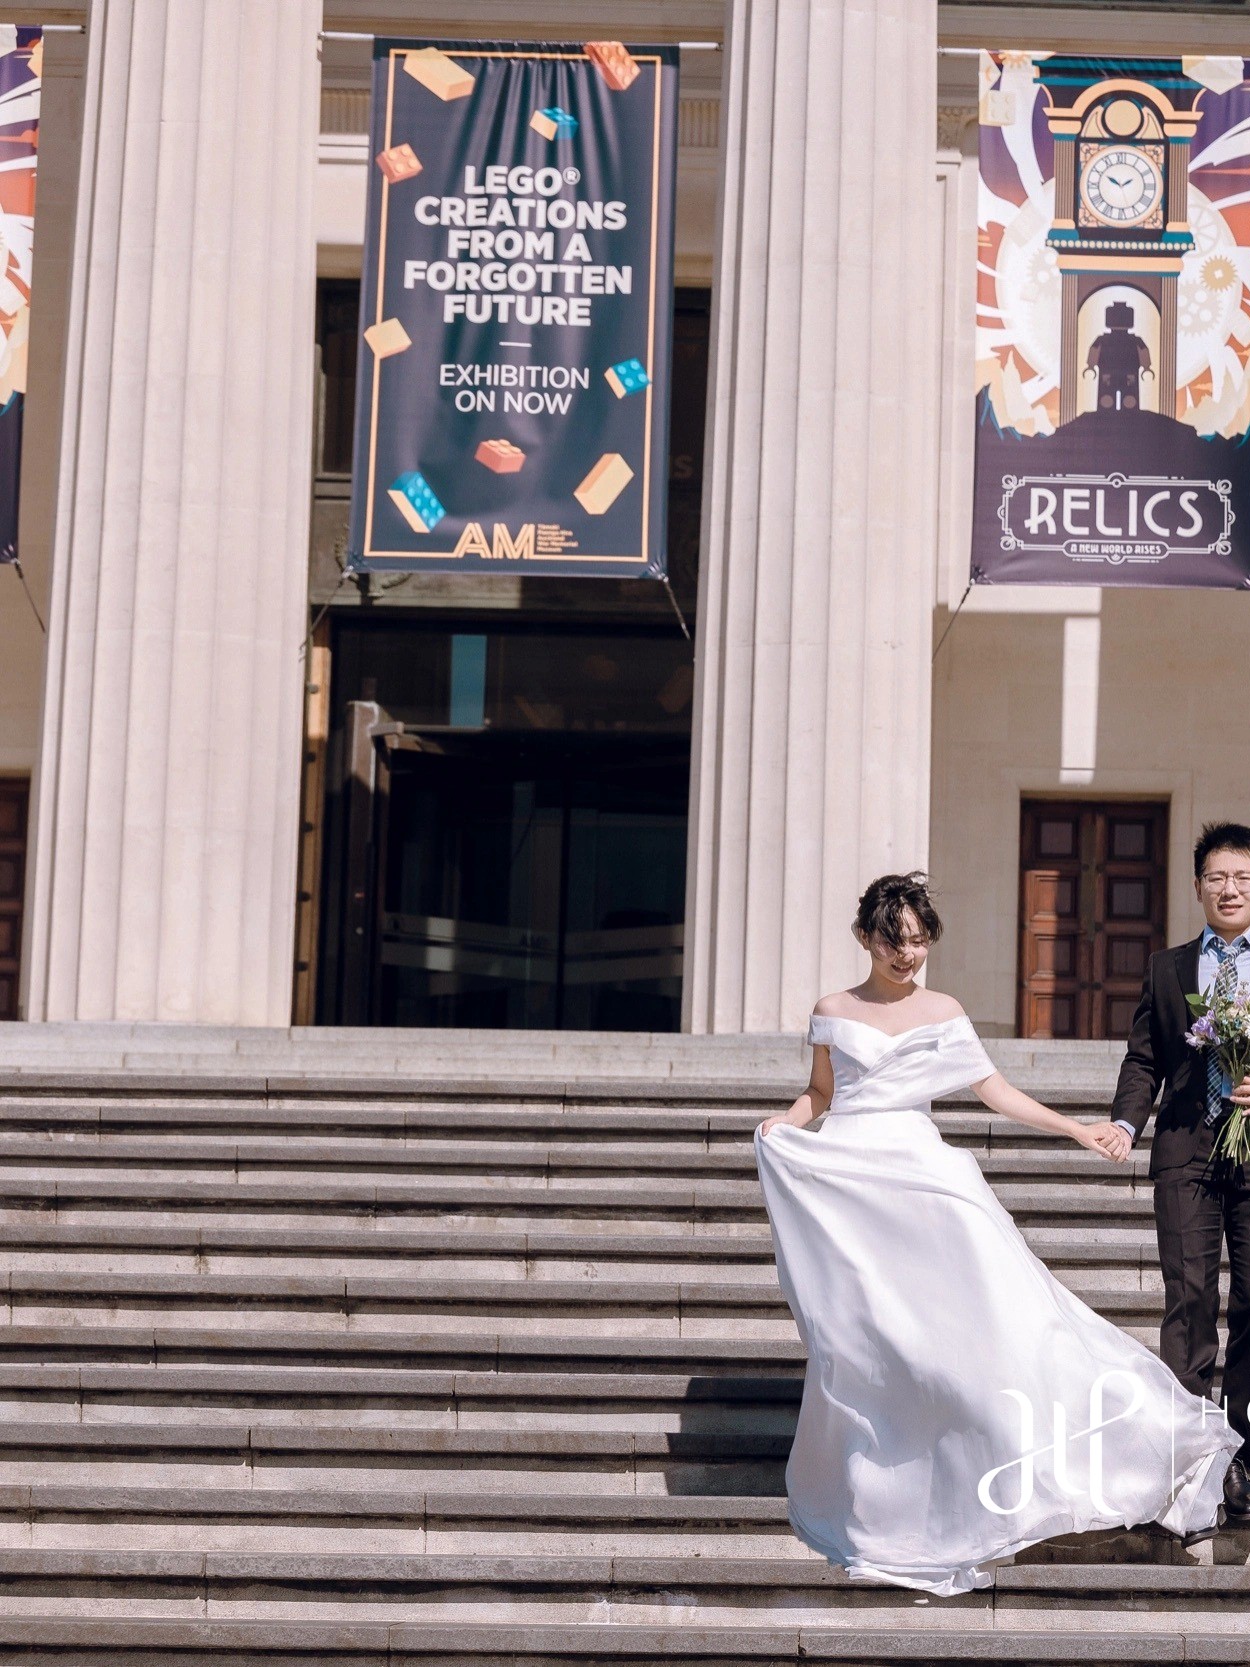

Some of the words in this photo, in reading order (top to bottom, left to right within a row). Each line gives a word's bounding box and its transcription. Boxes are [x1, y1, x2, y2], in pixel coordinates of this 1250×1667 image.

[414, 196, 628, 230] CREATIONS
[447, 229, 555, 260] FROM
[562, 233, 593, 262] A
[404, 260, 633, 294] FORGOTTEN
[443, 294, 592, 326] FUTURE
[439, 363, 590, 389] EXHIBITION
[455, 390, 496, 412] ON
[503, 390, 573, 415] NOW
[1024, 487, 1203, 537] RELICS
[453, 522, 535, 559] AM
[1070, 544, 1077, 553] A
[1079, 544, 1099, 553] NEW
[1101, 544, 1133, 554] WORLD
[1134, 545, 1161, 555] RISES
